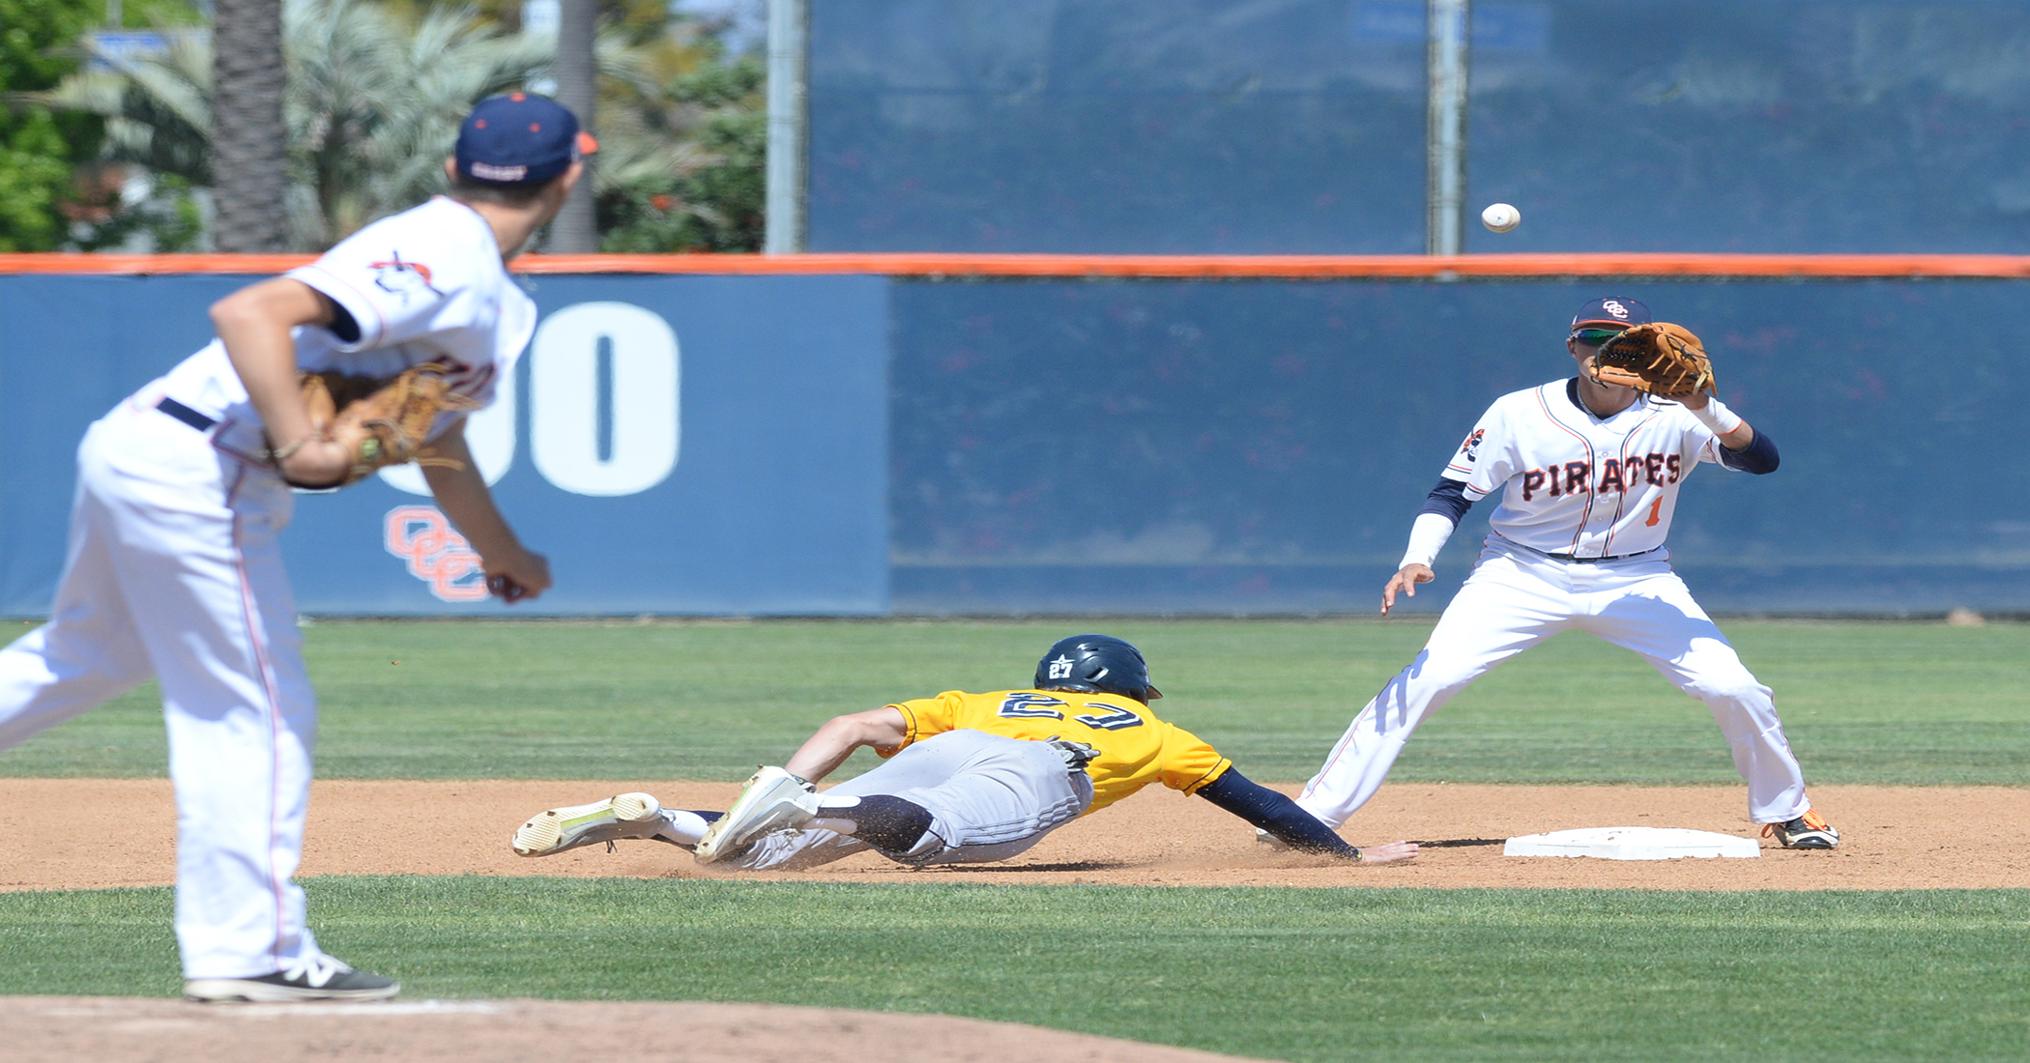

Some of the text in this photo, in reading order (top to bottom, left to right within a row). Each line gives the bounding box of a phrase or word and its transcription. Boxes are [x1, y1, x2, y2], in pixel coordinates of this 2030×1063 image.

[1522, 452, 1681, 502] PIRATES
[1645, 495, 1664, 528] 1
[1048, 662, 1074, 680] 27
[997, 692, 1144, 731] 27
